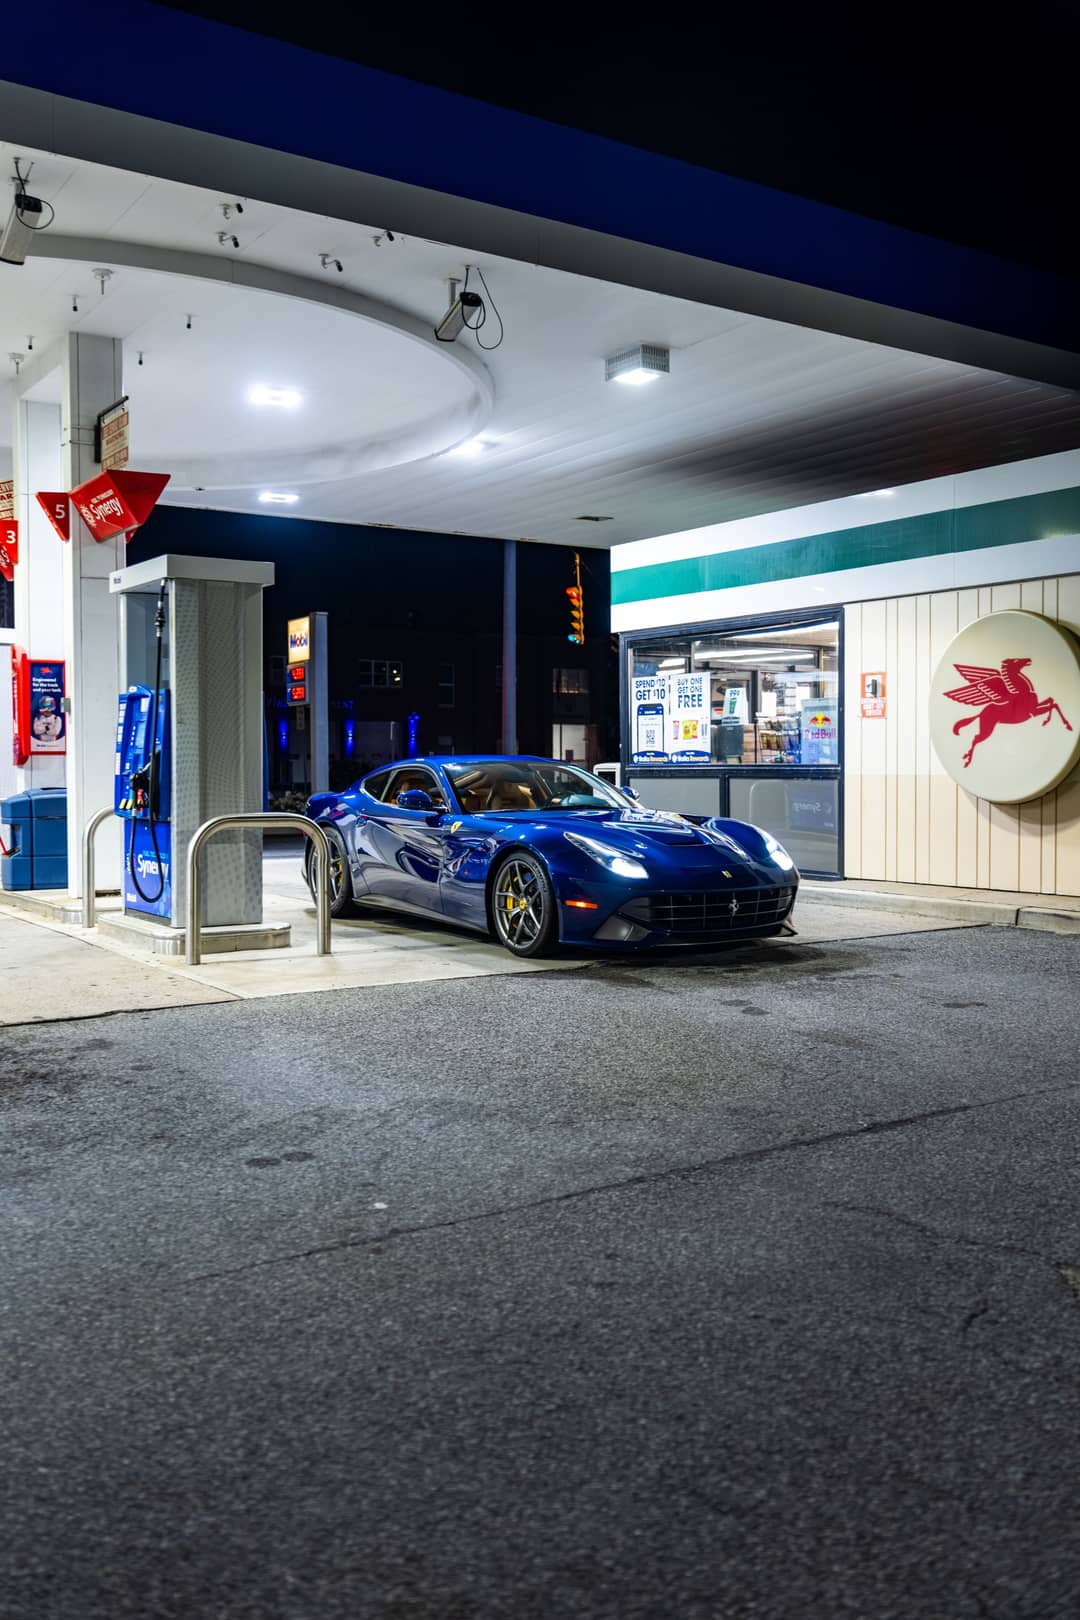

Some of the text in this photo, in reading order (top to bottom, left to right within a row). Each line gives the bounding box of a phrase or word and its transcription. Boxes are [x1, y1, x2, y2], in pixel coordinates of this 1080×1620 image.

[55, 504, 66, 519] 5
[90, 496, 124, 522] Synergy
[6, 530, 16, 544] 3
[635, 679, 655, 689] SPEND
[677, 677, 702, 686] BUY ONE
[635, 689, 651, 701] GET
[677, 685, 702, 694] GET ONE
[677, 693, 703, 709] FREE
